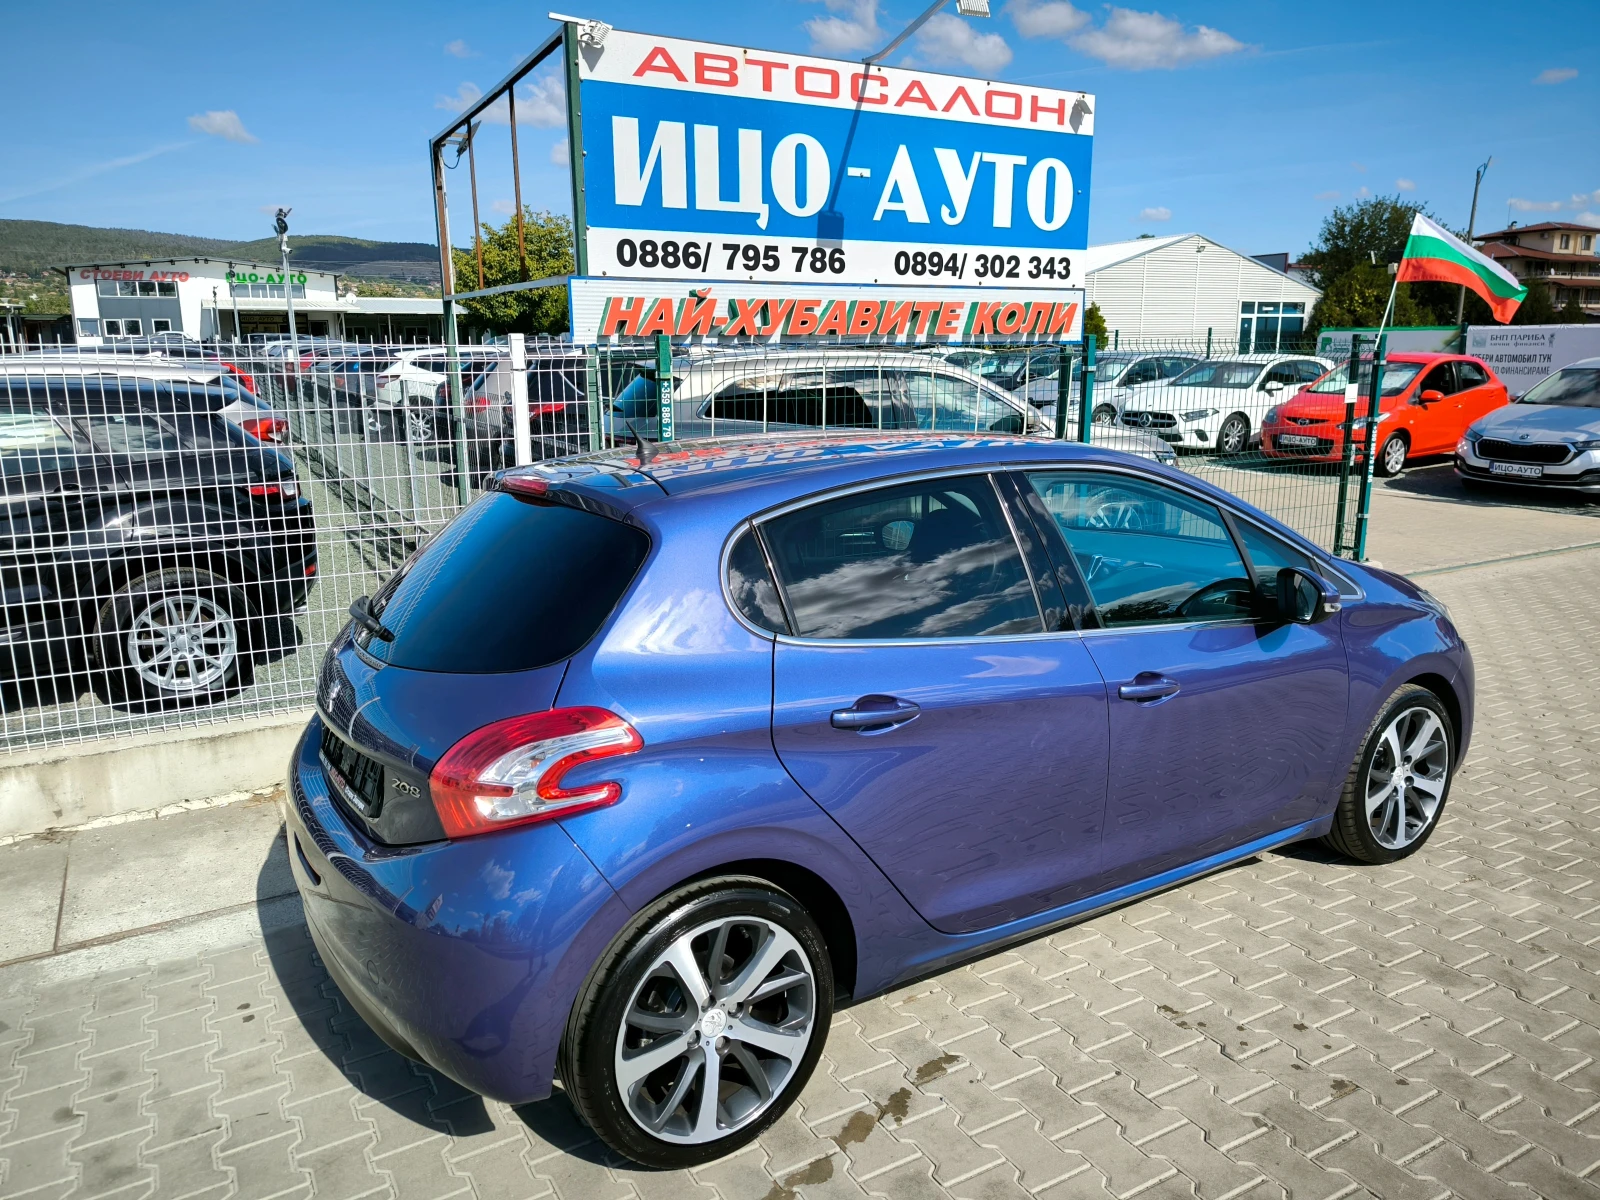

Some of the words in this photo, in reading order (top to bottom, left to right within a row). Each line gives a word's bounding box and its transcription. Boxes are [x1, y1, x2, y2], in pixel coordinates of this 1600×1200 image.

[632, 46, 1066, 126] АВТОСАЛОН
[616, 238, 713, 272] 0886/
[722, 243, 780, 272] 795
[791, 246, 846, 274] 786
[894, 250, 968, 279] 0894/
[974, 254, 1021, 279] 302
[1027, 256, 1071, 280] 343
[80, 268, 144, 281] СТОЕВИ
[148, 270, 190, 283] АУТО
[601, 287, 965, 336] НАЙ-ХУБАВИТЕ
[969, 301, 1079, 336] КОЛИ
[1510, 333, 1546, 341] ПАРИБА
[1494, 353, 1537, 364] АВТОМОБИЛ
[1500, 365, 1550, 376] ФИНАНСИРАМЕ
[661, 381, 671, 405] +359
[661, 406, 671, 424] 886
[662, 425, 672, 438] 79
[1494, 464, 1541, 475] ИЦО-АУТО
[391, 778, 421, 799] 208
